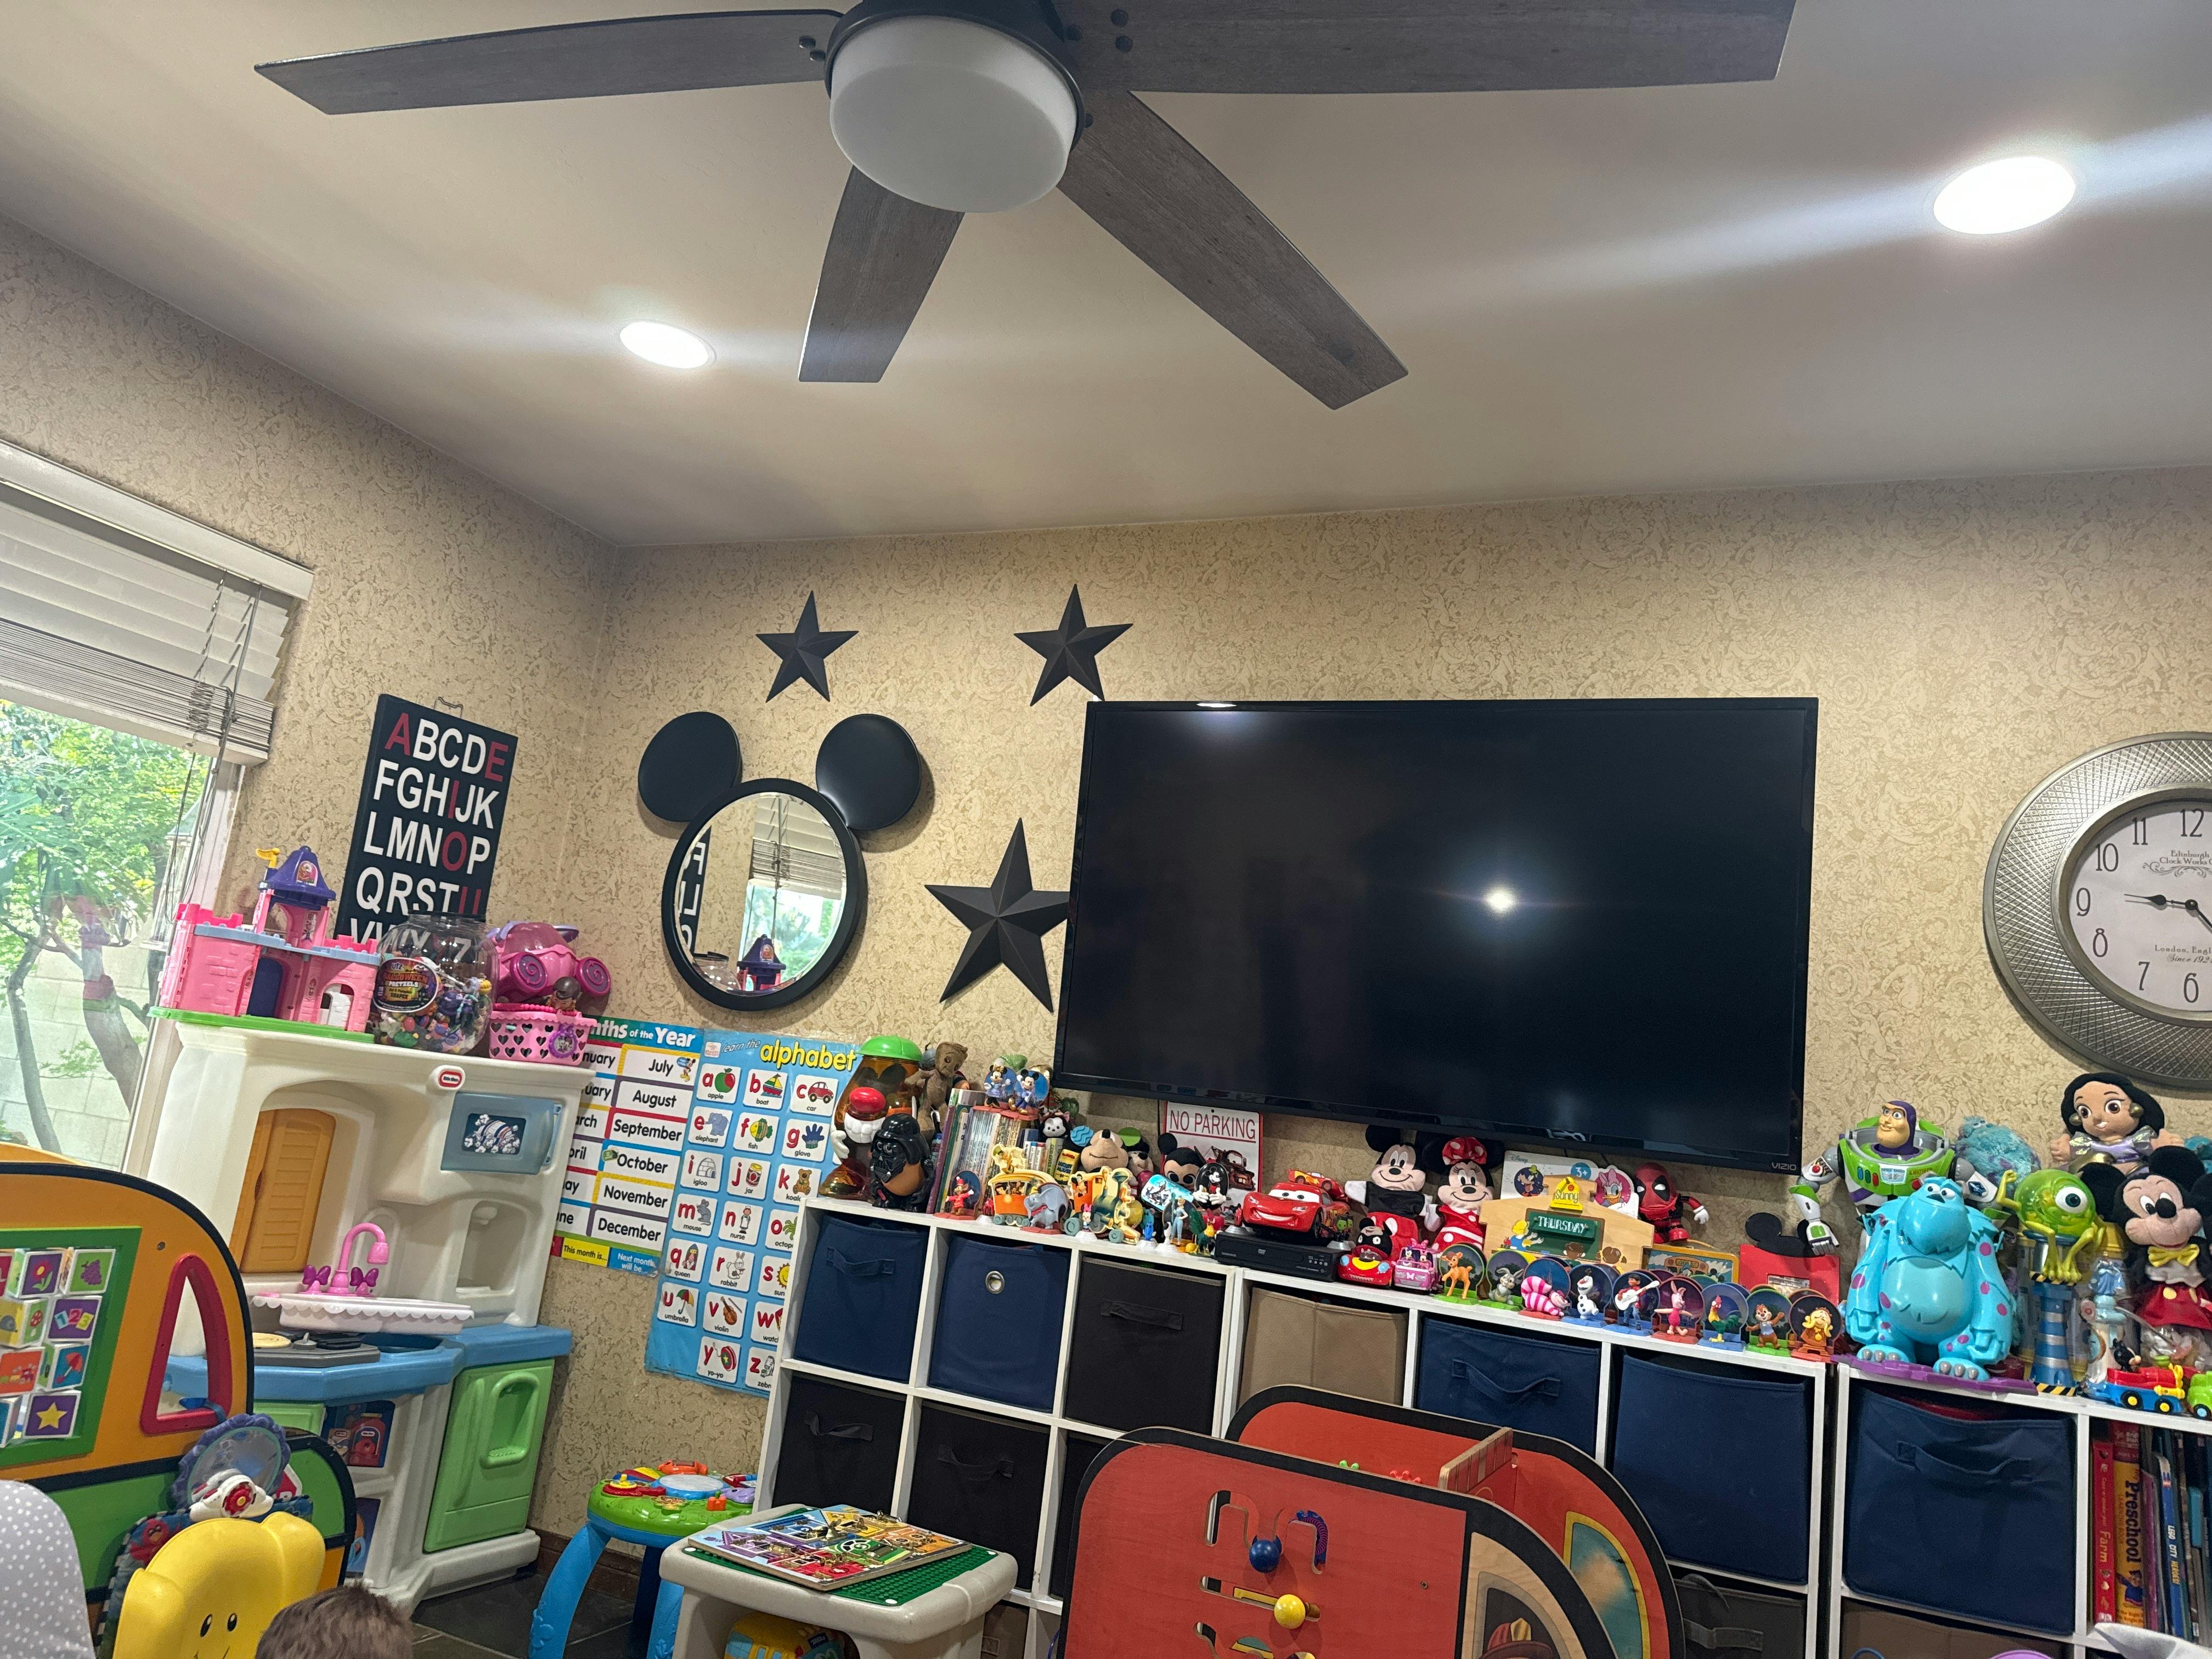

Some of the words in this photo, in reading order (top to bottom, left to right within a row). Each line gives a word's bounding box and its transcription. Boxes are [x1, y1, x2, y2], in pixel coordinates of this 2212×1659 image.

[385, 713, 509, 782] ABCDE
[373, 759, 499, 829] FGHIJK
[2180, 808, 2204, 837] 12
[2132, 817, 2148, 845] 11
[363, 811, 490, 874] LMNOP
[2096, 843, 2119, 872] 10
[2171, 850, 2209, 859] Edinburgh
[2076, 888, 2091, 917] 9
[2092, 928, 2108, 957] 8
[2192, 946, 2211, 955] Engl
[2138, 962, 2150, 990] 7
[2183, 973, 2199, 1003] 6
[591, 1020, 628, 1039] nths
[629, 1029, 639, 1037] of
[640, 1030, 653, 1040] the
[654, 1026, 696, 1047] Year
[722, 1042, 745, 1053] learn
[746, 1039, 761, 1048] the
[582, 1050, 616, 1069] nuary
[760, 1039, 857, 1071] alphabet
[648, 1059, 674, 1077] July
[702, 1073, 714, 1088] a
[749, 1073, 761, 1093] b
[583, 1085, 612, 1101] uary
[633, 1090, 677, 1108] August
[796, 1084, 808, 1099] c
[576, 1114, 597, 1128] arch
[694, 1115, 705, 1131] e
[740, 1118, 751, 1138] f
[1170, 1110, 1189, 1131] NO
[1194, 1113, 1256, 1139] PARKING
[613, 1118, 682, 1142] September
[695, 1135, 719, 1144] elephant
[786, 1128, 800, 1149] g
[568, 1146, 586, 1160] pril
[794, 1149, 811, 1158] glove
[1510, 1154, 1528, 1164] Disney
[617, 1153, 669, 1173] October
[687, 1154, 695, 1175] i
[1771, 1161, 1797, 1171] VIZIO
[731, 1161, 742, 1187] j
[778, 1167, 790, 1190] k
[1575, 1167, 1588, 1177] 3+
[563, 1180, 580, 1195] ay
[693, 1178, 708, 1187] igloo
[603, 1184, 669, 1208] November
[1555, 1189, 1579, 1204] Sunny
[678, 1203, 696, 1220] m
[725, 1211, 736, 1227] n
[598, 1218, 661, 1242] December
[683, 1223, 702, 1232] mouse
[771, 1219, 782, 1235] o
[1538, 1215, 1586, 1234] THURSDAY
[730, 1232, 746, 1240] nurse
[563, 1245, 575, 1254] This
[576, 1247, 596, 1259] month
[775, 1240, 793, 1249] octop
[617, 1252, 633, 1262] Next
[670, 1248, 682, 1269] q
[716, 1256, 725, 1272] r
[674, 1270, 691, 1278] queen
[763, 1266, 774, 1282] s
[720, 1279, 738, 1288] rabbit
[663, 1291, 674, 1307] u
[709, 1301, 719, 1317] v
[664, 1313, 689, 1323] umbrella
[757, 1311, 775, 1329] w
[714, 1324, 729, 1333] violin
[704, 1345, 714, 1366] y
[749, 1357, 761, 1374] z
[708, 1369, 724, 1379] yo-yo
[757, 1380, 772, 1389] zebr
[2125, 1480, 2142, 1563] Preschool
[2167, 1525, 2176, 1540] LEGO
[2100, 1530, 2112, 1563] Farm
[2169, 1544, 2177, 1559] CITY
